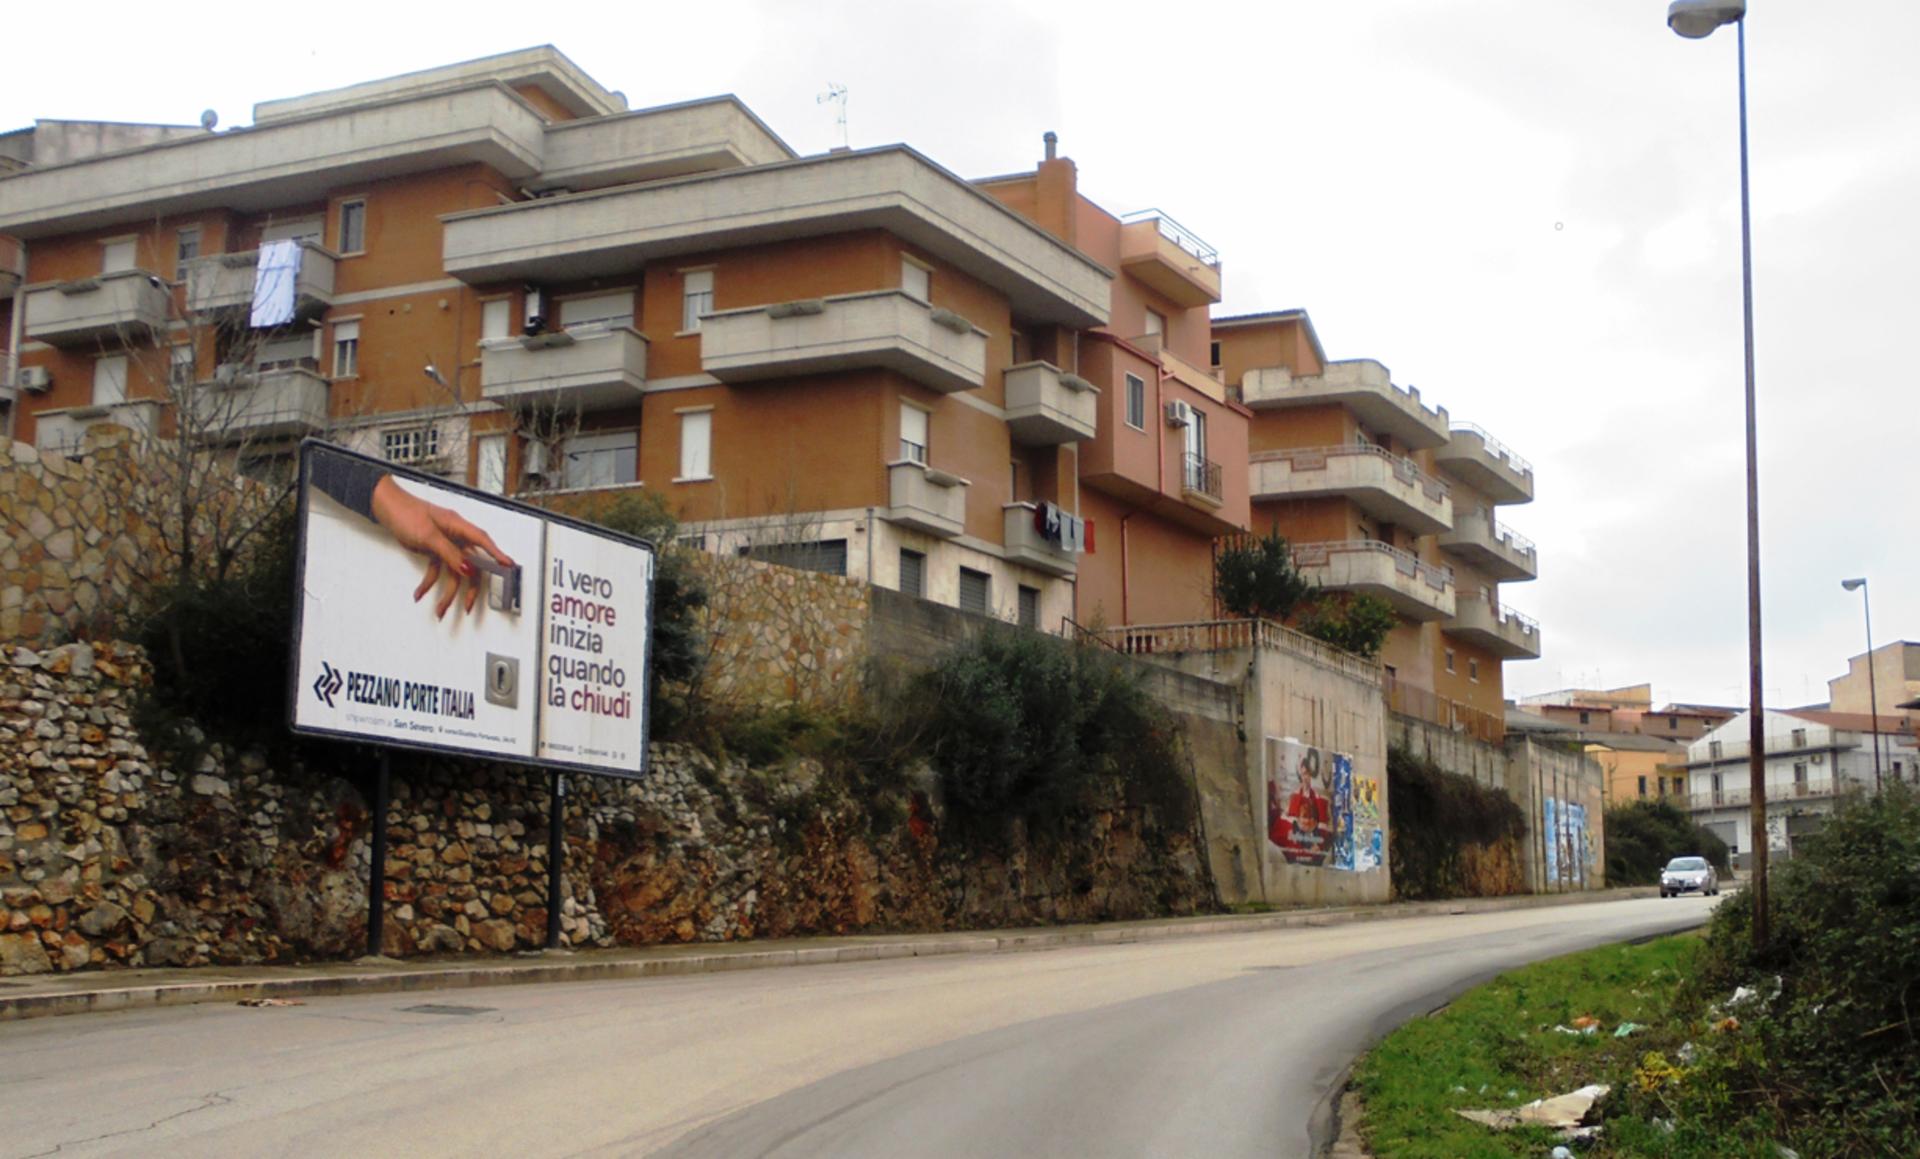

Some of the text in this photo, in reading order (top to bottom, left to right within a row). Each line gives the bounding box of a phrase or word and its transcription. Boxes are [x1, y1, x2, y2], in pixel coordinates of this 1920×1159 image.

[552, 558, 613, 600] il vero
[551, 593, 617, 627] amore
[550, 616, 604, 654] inizia
[548, 654, 626, 689] quando
[346, 671, 475, 720] PEZZANO PORTE ITALIA
[548, 678, 632, 720] la chiudi
[394, 718, 408, 729] San
[409, 721, 434, 733] Severo
